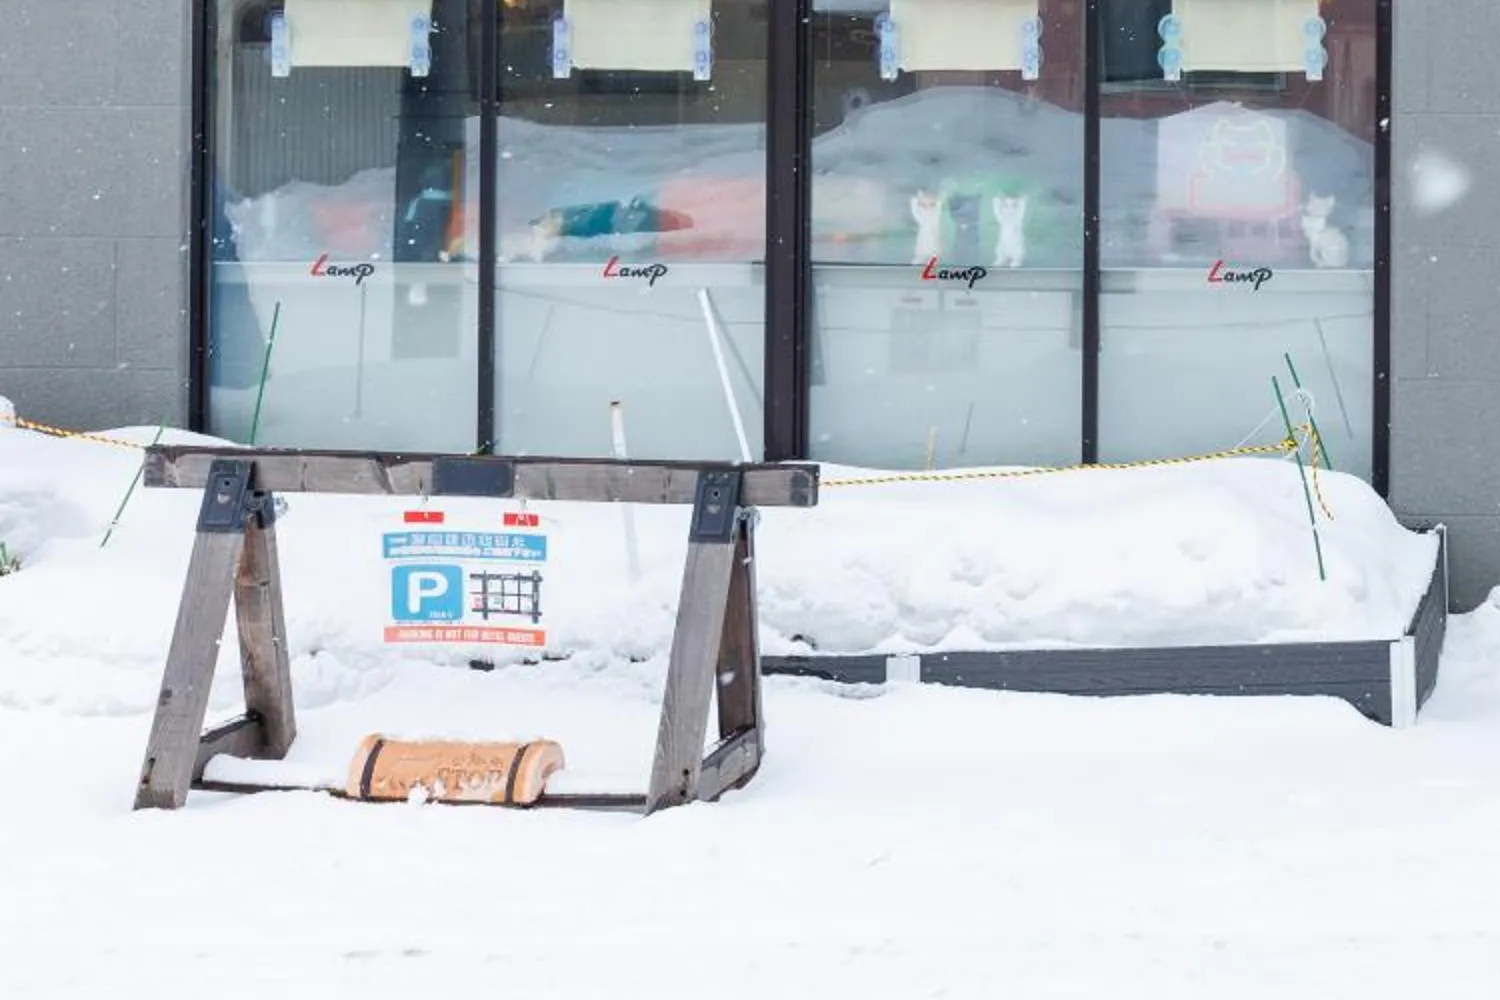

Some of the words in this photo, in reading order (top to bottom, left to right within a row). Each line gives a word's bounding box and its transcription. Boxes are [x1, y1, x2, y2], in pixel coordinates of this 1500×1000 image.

[311, 253, 375, 286] Lamp
[604, 255, 668, 288] Lamp
[922, 256, 987, 289] Lamp
[1207, 260, 1273, 291] Lamp
[407, 570, 450, 615] P
